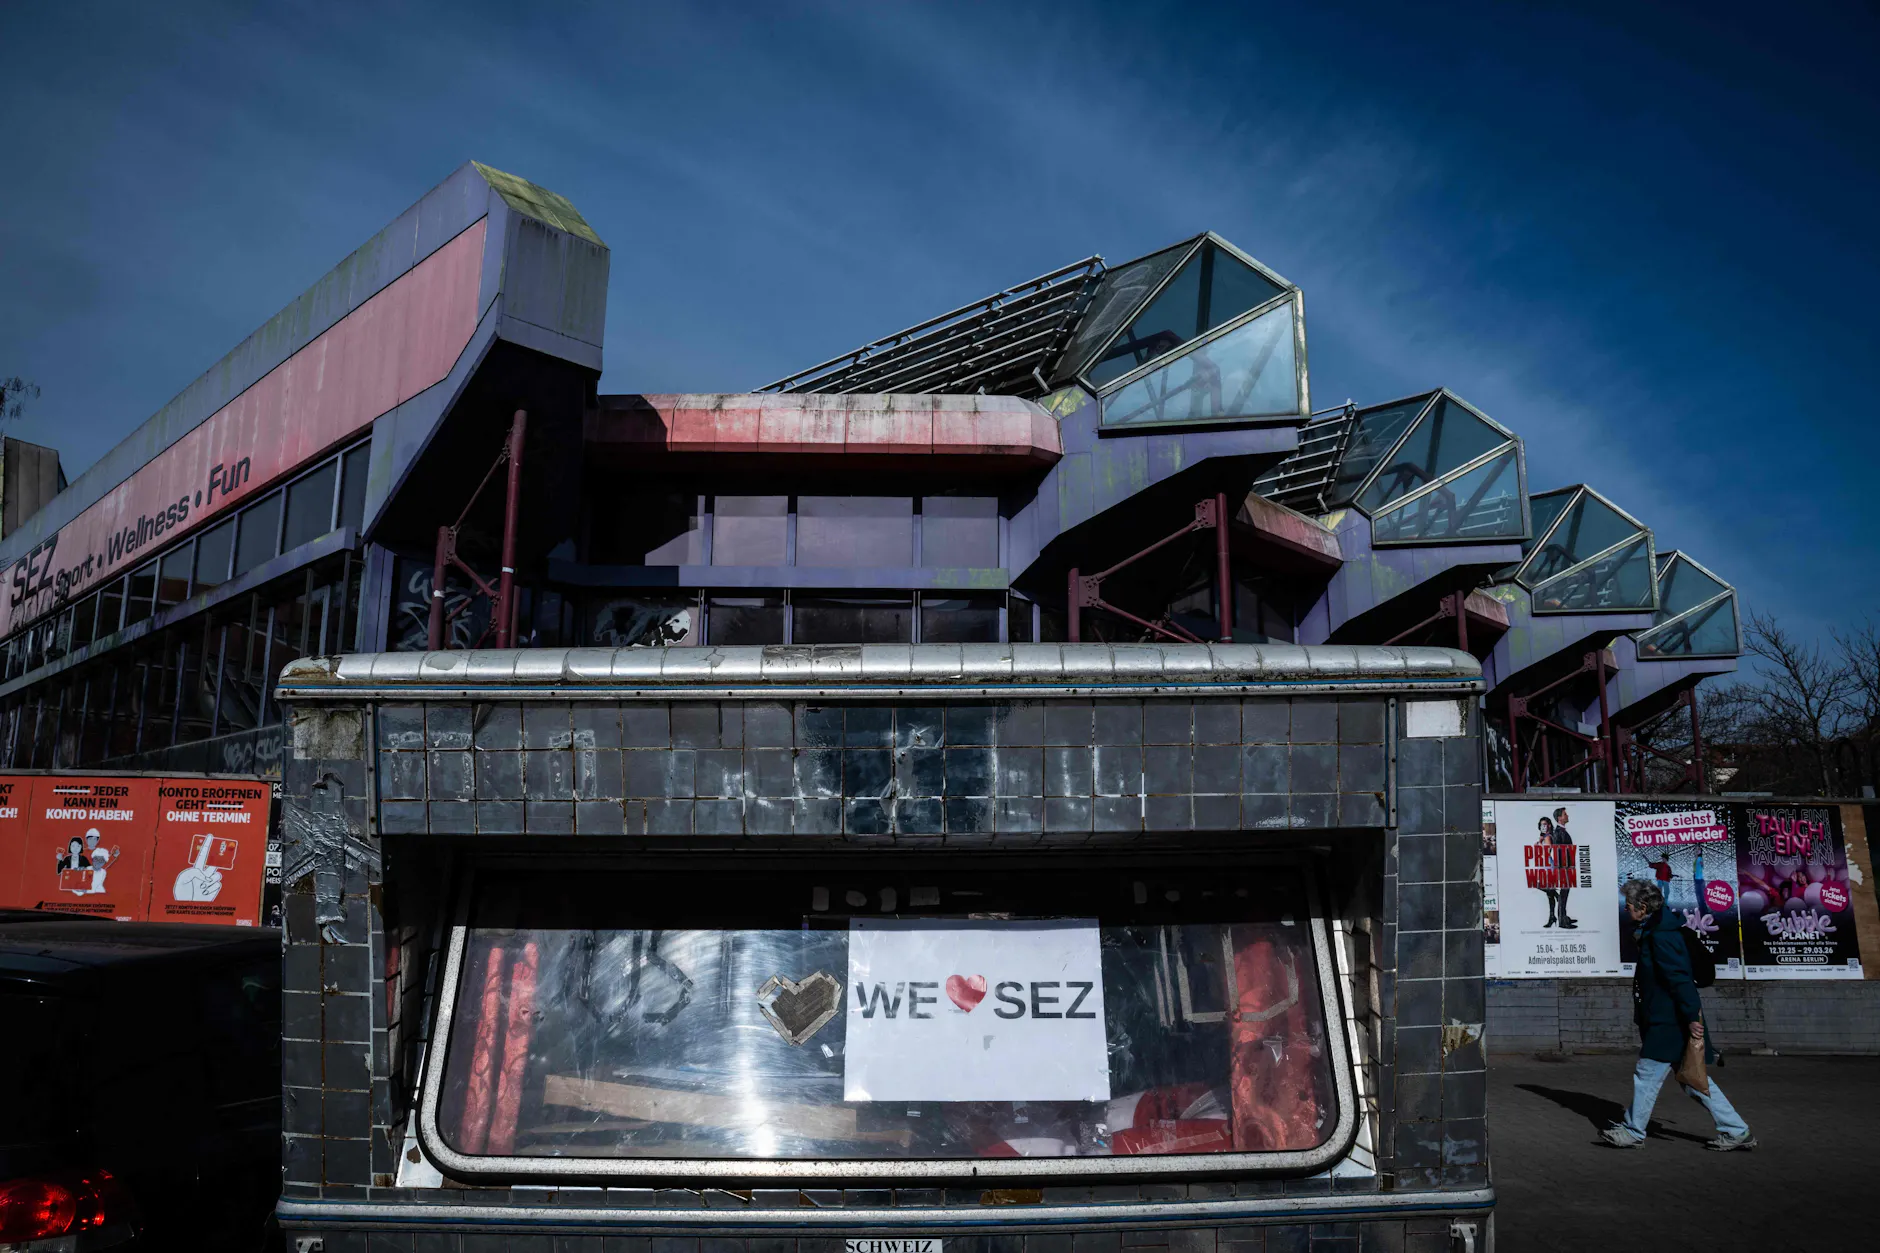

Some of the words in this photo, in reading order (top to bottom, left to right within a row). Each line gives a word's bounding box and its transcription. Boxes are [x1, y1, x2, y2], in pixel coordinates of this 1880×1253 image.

[55, 554, 94, 598] Sport
[107, 495, 190, 566] Wellness
[207, 456, 251, 506] Fun
[11, 533, 59, 608] SEZ
[54, 785, 90, 795] NICHT
[92, 786, 129, 797] JEDER
[158, 787, 199, 797] KONTO
[202, 786, 262, 799] ERÖFFNEN
[64, 797, 96, 808] KANN
[98, 798, 118, 808] EIN
[176, 800, 206, 810] GEHT
[207, 800, 244, 810] NICHT
[45, 808, 87, 820] KONTO
[88, 809, 134, 821] HABEN!
[166, 811, 200, 822] OHNE
[202, 811, 251, 823] TERMIN!
[1627, 817, 1669, 830] Sowas
[1673, 813, 1711, 826] siehst
[1755, 814, 1825, 841] TAUCH
[1634, 831, 1653, 845] du
[1655, 829, 1677, 844] nie
[1678, 827, 1725, 842] wieder
[1775, 835, 1812, 859] EIN!
[1524, 844, 1577, 867] PRETTY
[1579, 845, 1591, 874] MUSICAL
[1525, 868, 1577, 889] WOMAN
[1580, 875, 1592, 888] DAS
[1706, 887, 1732, 902] Tickets
[1821, 889, 1847, 903] Tickets
[1760, 908, 1838, 937] Bubble
[1781, 930, 1820, 941] PLANET
[1536, 944, 1555, 953] 15.04.
[1560, 944, 1587, 953] 03.05.26
[1769, 946, 1796, 954] 12.12.25
[1802, 946, 1834, 954] 29.03.26
[1528, 955, 1576, 966] Admiralspalast
[1576, 955, 1596, 965] Berlin
[855, 981, 939, 1019] WE
[993, 981, 1097, 1020] SEZ
[845, 1240, 933, 1253] SCHWEIZ
